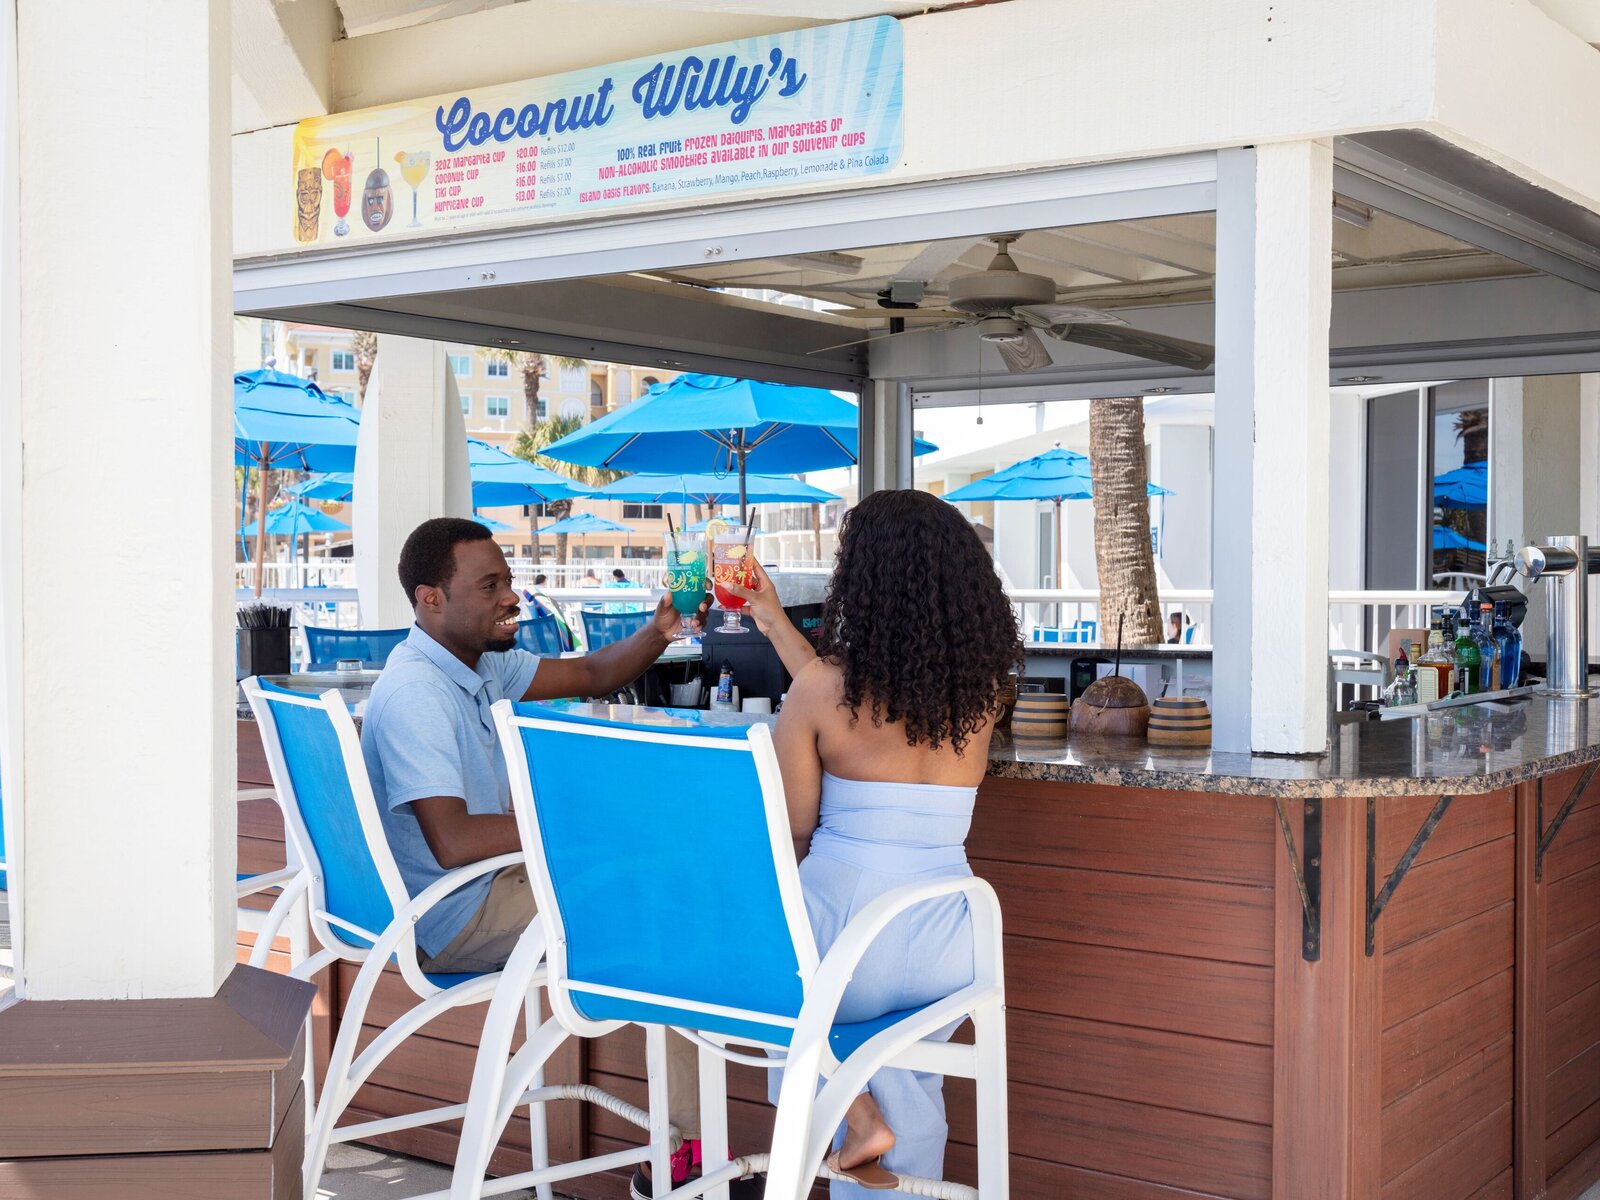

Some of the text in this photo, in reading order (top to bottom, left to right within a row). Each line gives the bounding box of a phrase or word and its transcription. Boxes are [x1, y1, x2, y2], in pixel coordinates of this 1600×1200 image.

[435, 47, 808, 153] Coconut Willy's
[841, 131, 865, 147] CUPS
[517, 146, 538, 159] $20.00
[541, 142, 575, 155] Refills $12.00
[617, 147, 635, 161] 100%
[493, 151, 505, 162] CUP
[516, 161, 536, 173] $16.00
[540, 158, 572, 170] Refills $7.00
[467, 169, 479, 180] CUP
[540, 172, 572, 185] Refills $7.00
[652, 180, 677, 193] Banana,
[678, 174, 714, 190] Strawberry,
[715, 172, 740, 187] Mango,
[801, 158, 838, 175] Lemonade
[839, 159, 846, 171] &
[847, 157, 863, 170] Pina
[864, 153, 889, 167] Colada
[516, 175, 536, 187] $16.00
[448, 186, 462, 197] CUP
[516, 190, 536, 202] $13.00
[540, 187, 572, 199] Refills $7.00
[471, 196, 484, 208] CUP
